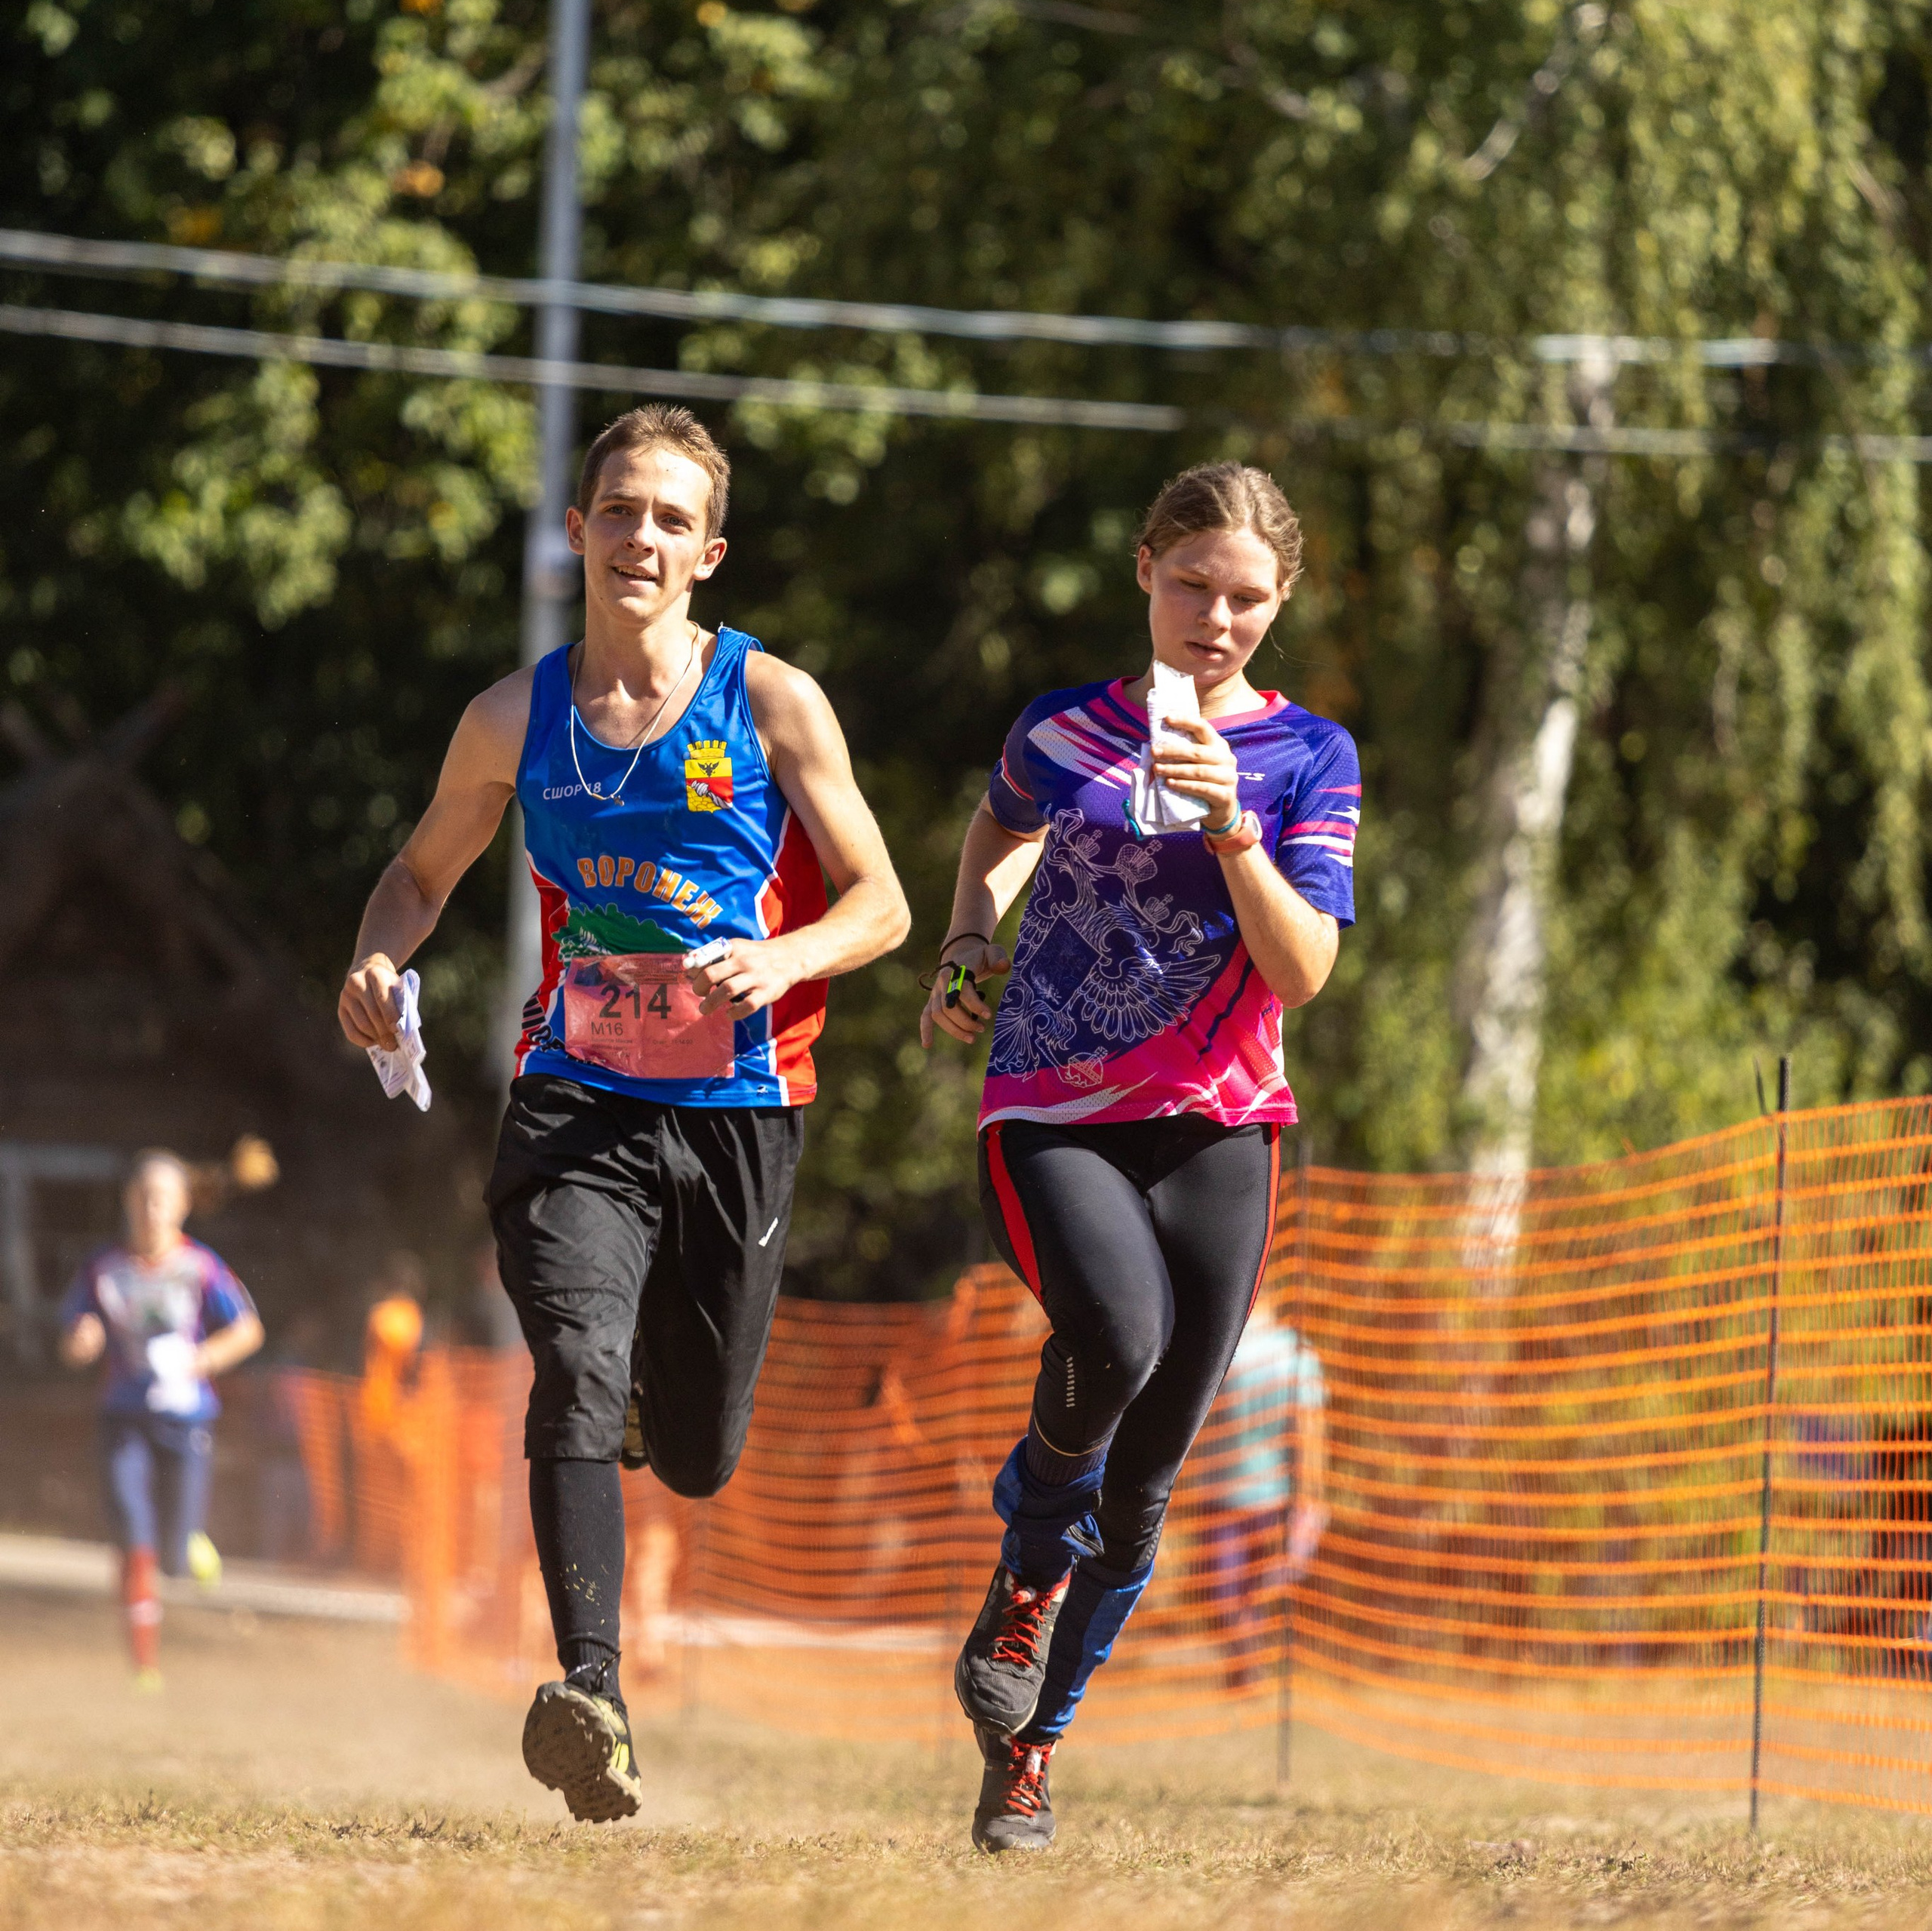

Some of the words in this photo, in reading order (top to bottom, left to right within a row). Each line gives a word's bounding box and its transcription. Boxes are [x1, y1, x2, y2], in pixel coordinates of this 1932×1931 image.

[543, 784, 583, 800] СШОР
[587, 782, 601, 795] 18
[577, 855, 724, 930] ВОРОНЕЖ
[599, 983, 672, 1019] 214
